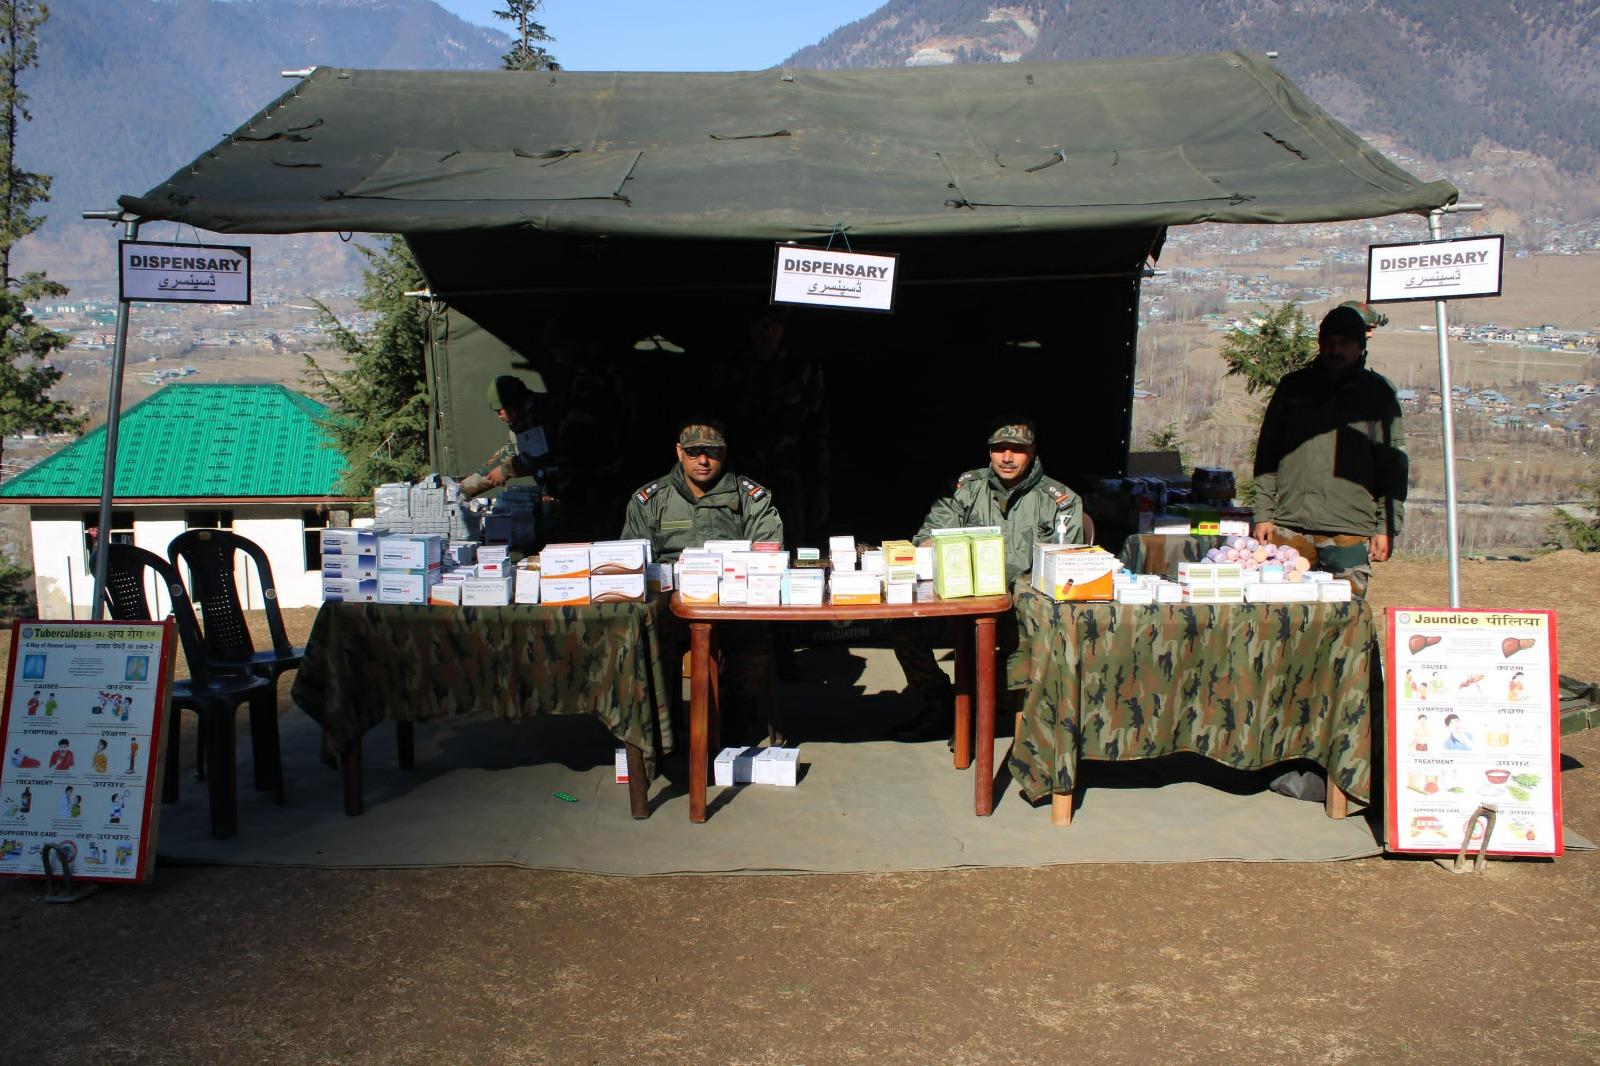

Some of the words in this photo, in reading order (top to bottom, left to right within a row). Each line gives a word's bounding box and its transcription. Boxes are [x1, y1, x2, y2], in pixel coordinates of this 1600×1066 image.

[130, 254, 241, 272] DISPENSARY
[1380, 250, 1489, 271] DISPENSARY
[784, 258, 889, 279] DISPENSARY
[1414, 614, 1479, 625] Jaundice
[1485, 614, 1541, 627] पीलिया
[34, 628, 92, 639] Tuberculosis
